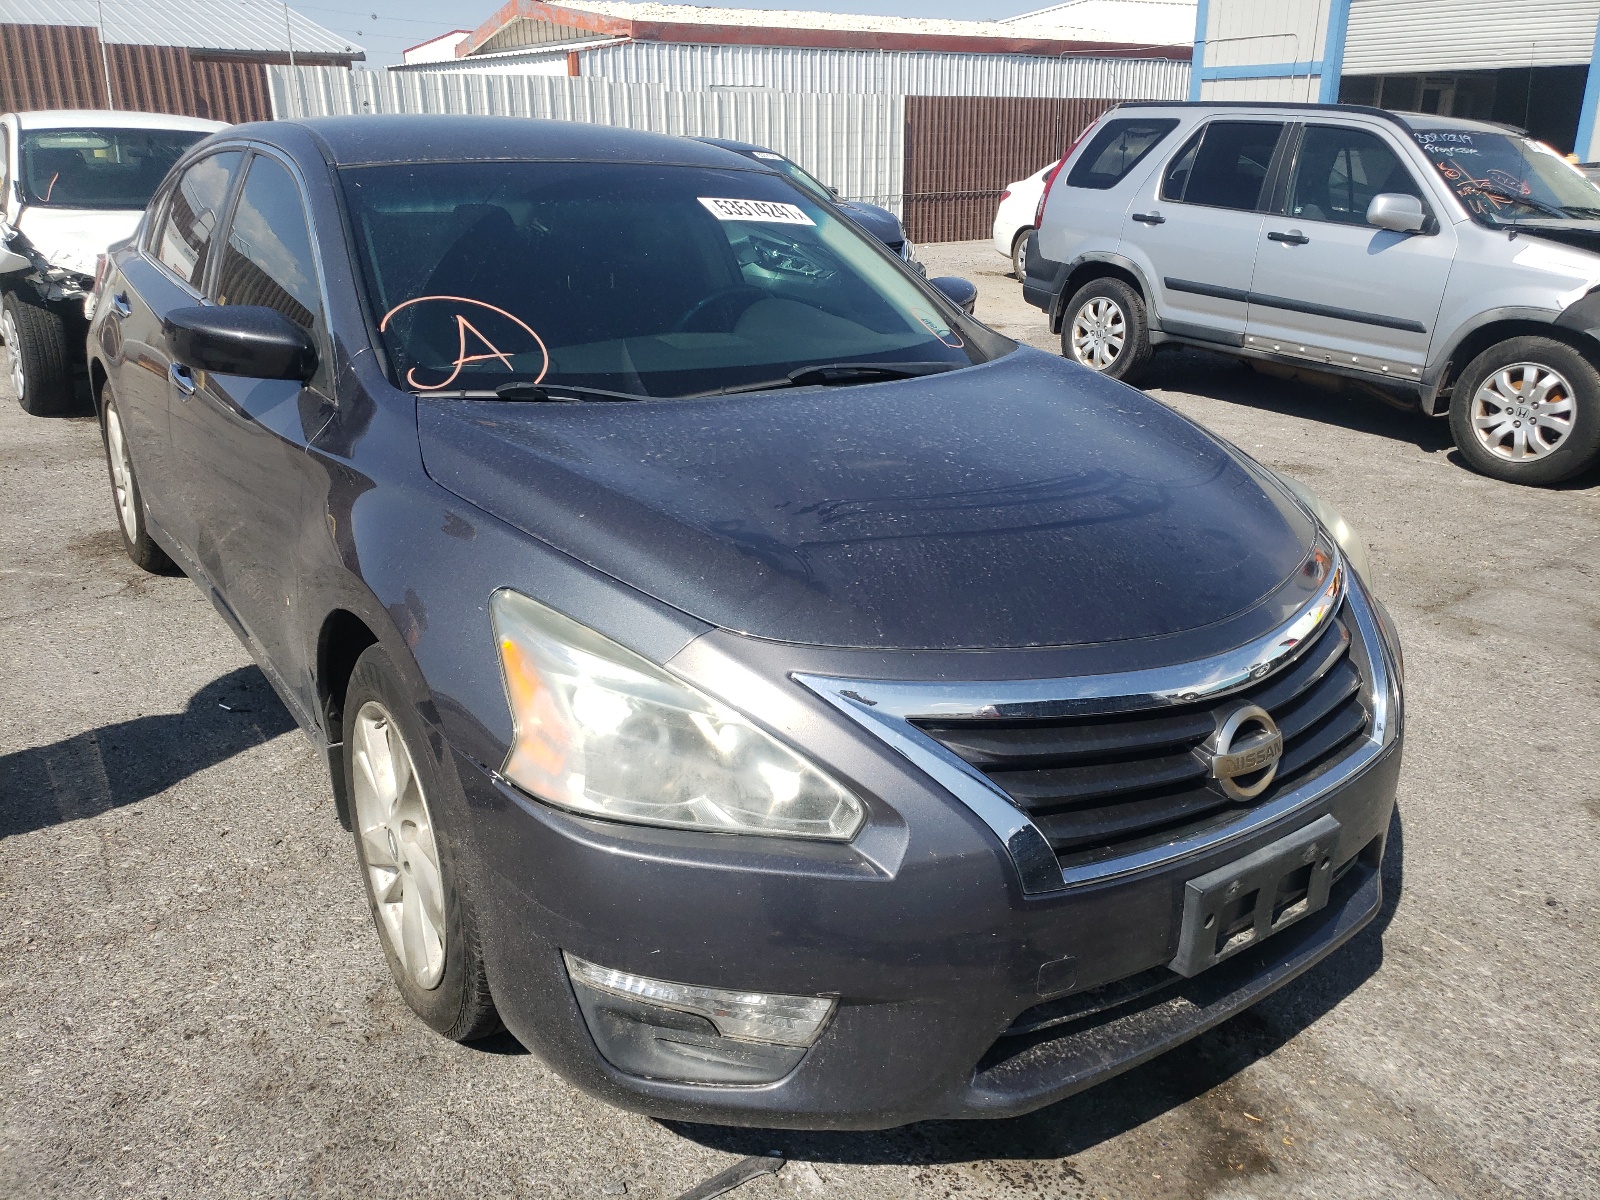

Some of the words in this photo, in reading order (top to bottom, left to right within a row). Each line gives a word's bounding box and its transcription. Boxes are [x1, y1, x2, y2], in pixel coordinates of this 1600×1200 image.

[712, 199, 798, 220] 53514241
[407, 314, 515, 390] A
[1226, 741, 1281, 773] NISSAN
